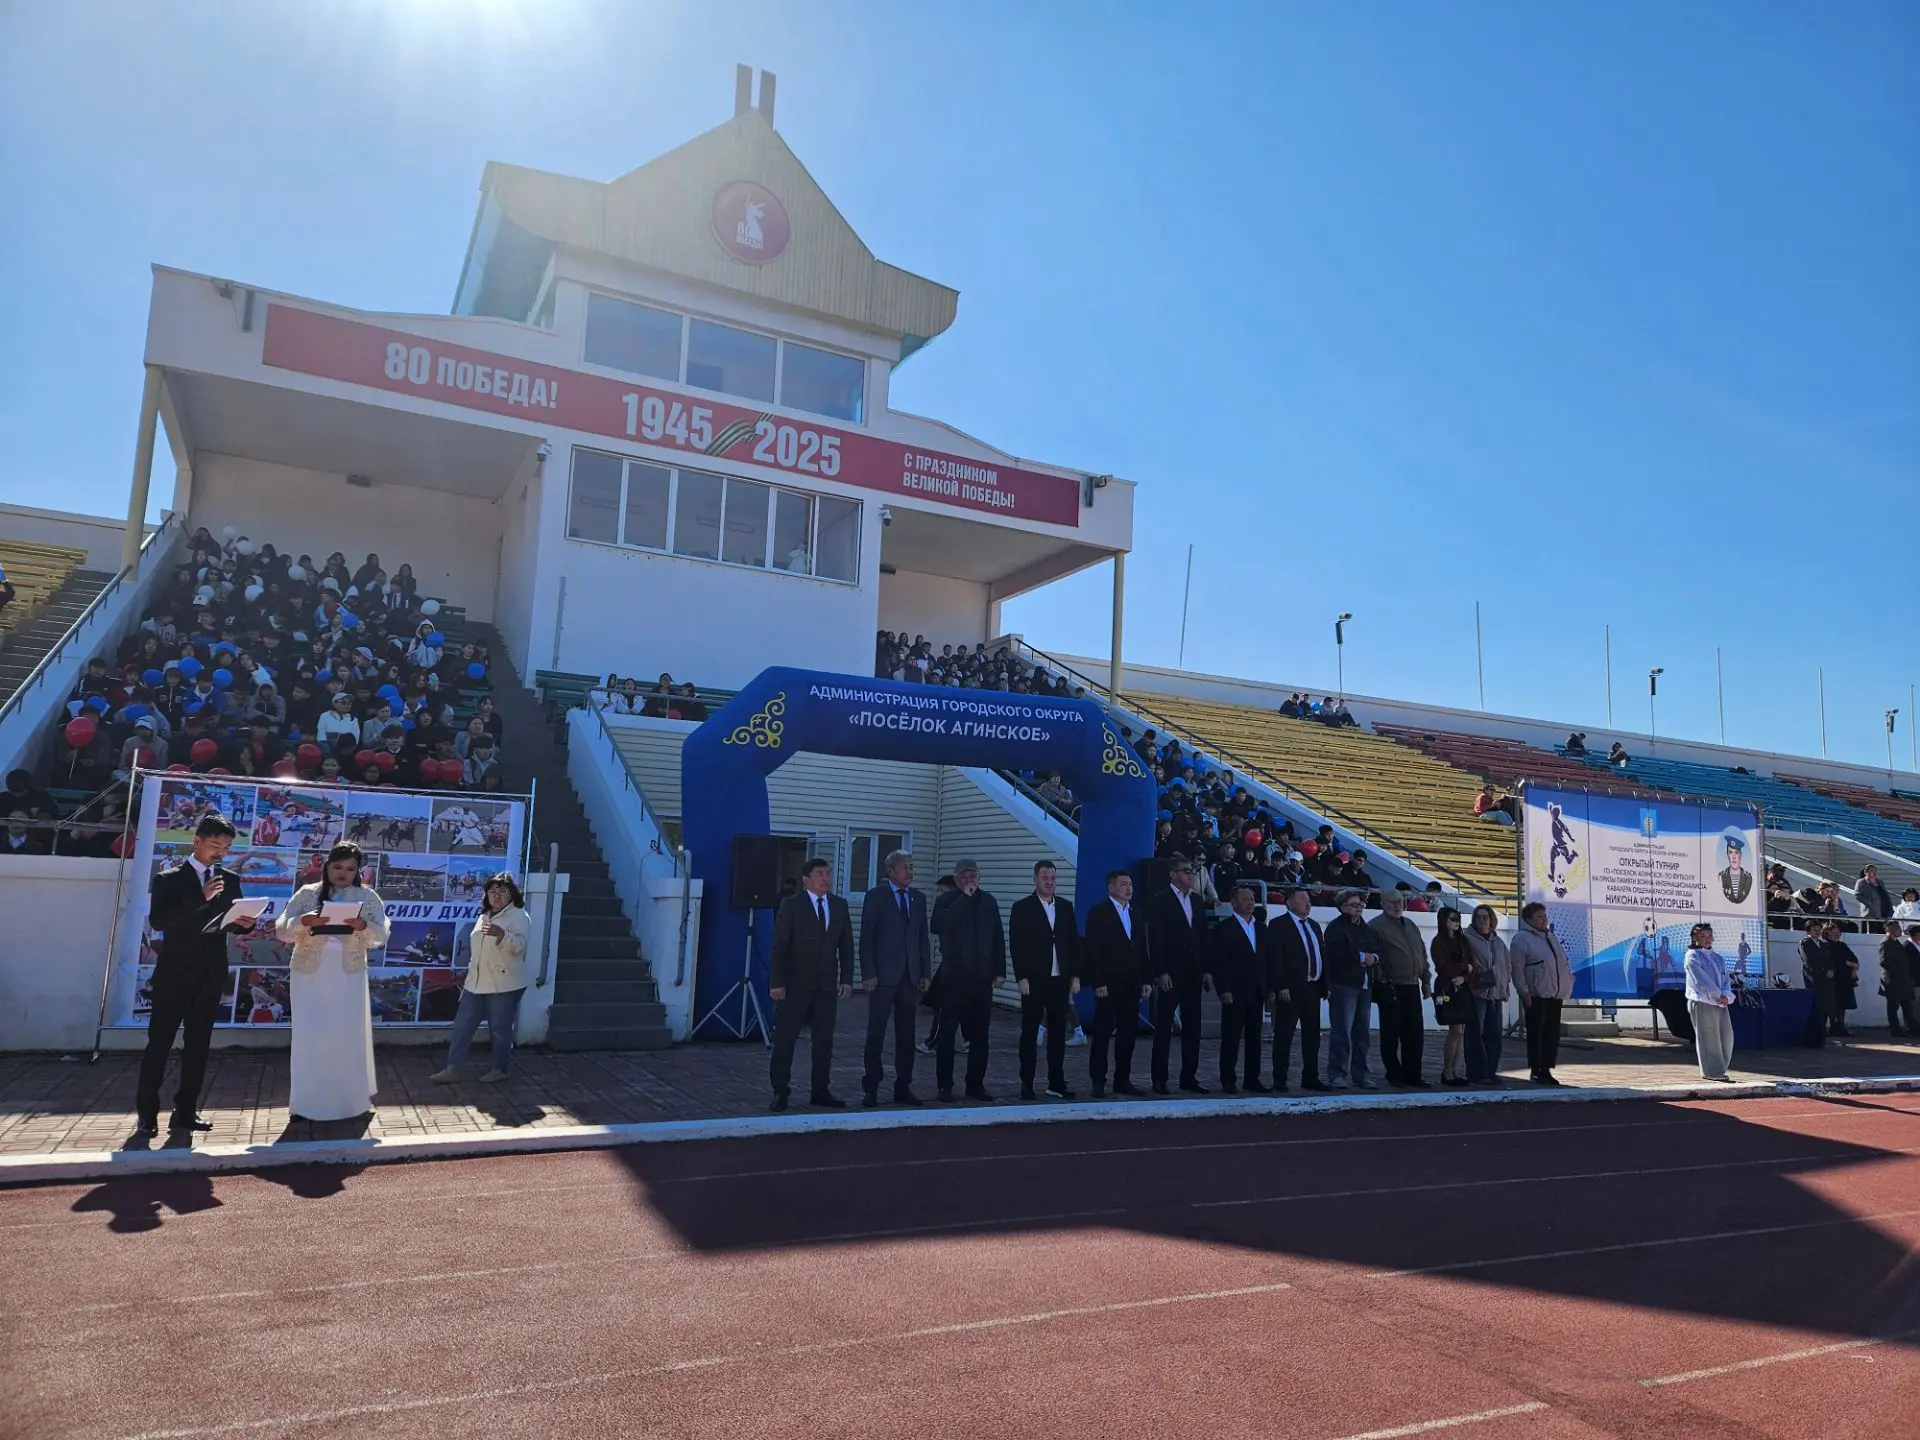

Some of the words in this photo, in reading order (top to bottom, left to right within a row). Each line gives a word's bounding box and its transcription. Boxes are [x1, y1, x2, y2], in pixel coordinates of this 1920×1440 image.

[384, 342, 431, 385] 80
[436, 358, 558, 409] ПОБЕДА!
[622, 392, 713, 449] 1945
[753, 421, 841, 476] 2025
[904, 452, 913, 468] С
[916, 455, 997, 486] ПРАЗДНИКОМ
[903, 471, 959, 497] ВЕЛИКОЙ
[962, 483, 1015, 508] ПОБЕДЫ!
[809, 684, 939, 711] АДМИНИСТРАЦИЯ
[942, 699, 1032, 717] ГОРОДСКОГО
[1035, 707, 1084, 723] ОКРУГА
[848, 710, 947, 734] «ПОСЁЛОК
[951, 720, 1050, 741] АГИНСКОЕ»
[1619, 857, 1654, 869] ОТКРЫТЫЙ
[1656, 860, 1680, 871] ТУРНИР
[385, 903, 434, 918] СИЛУ
[1605, 893, 1639, 906] НИКОНА
[1640, 896, 1695, 909] КОМОГОРЦЕВА
